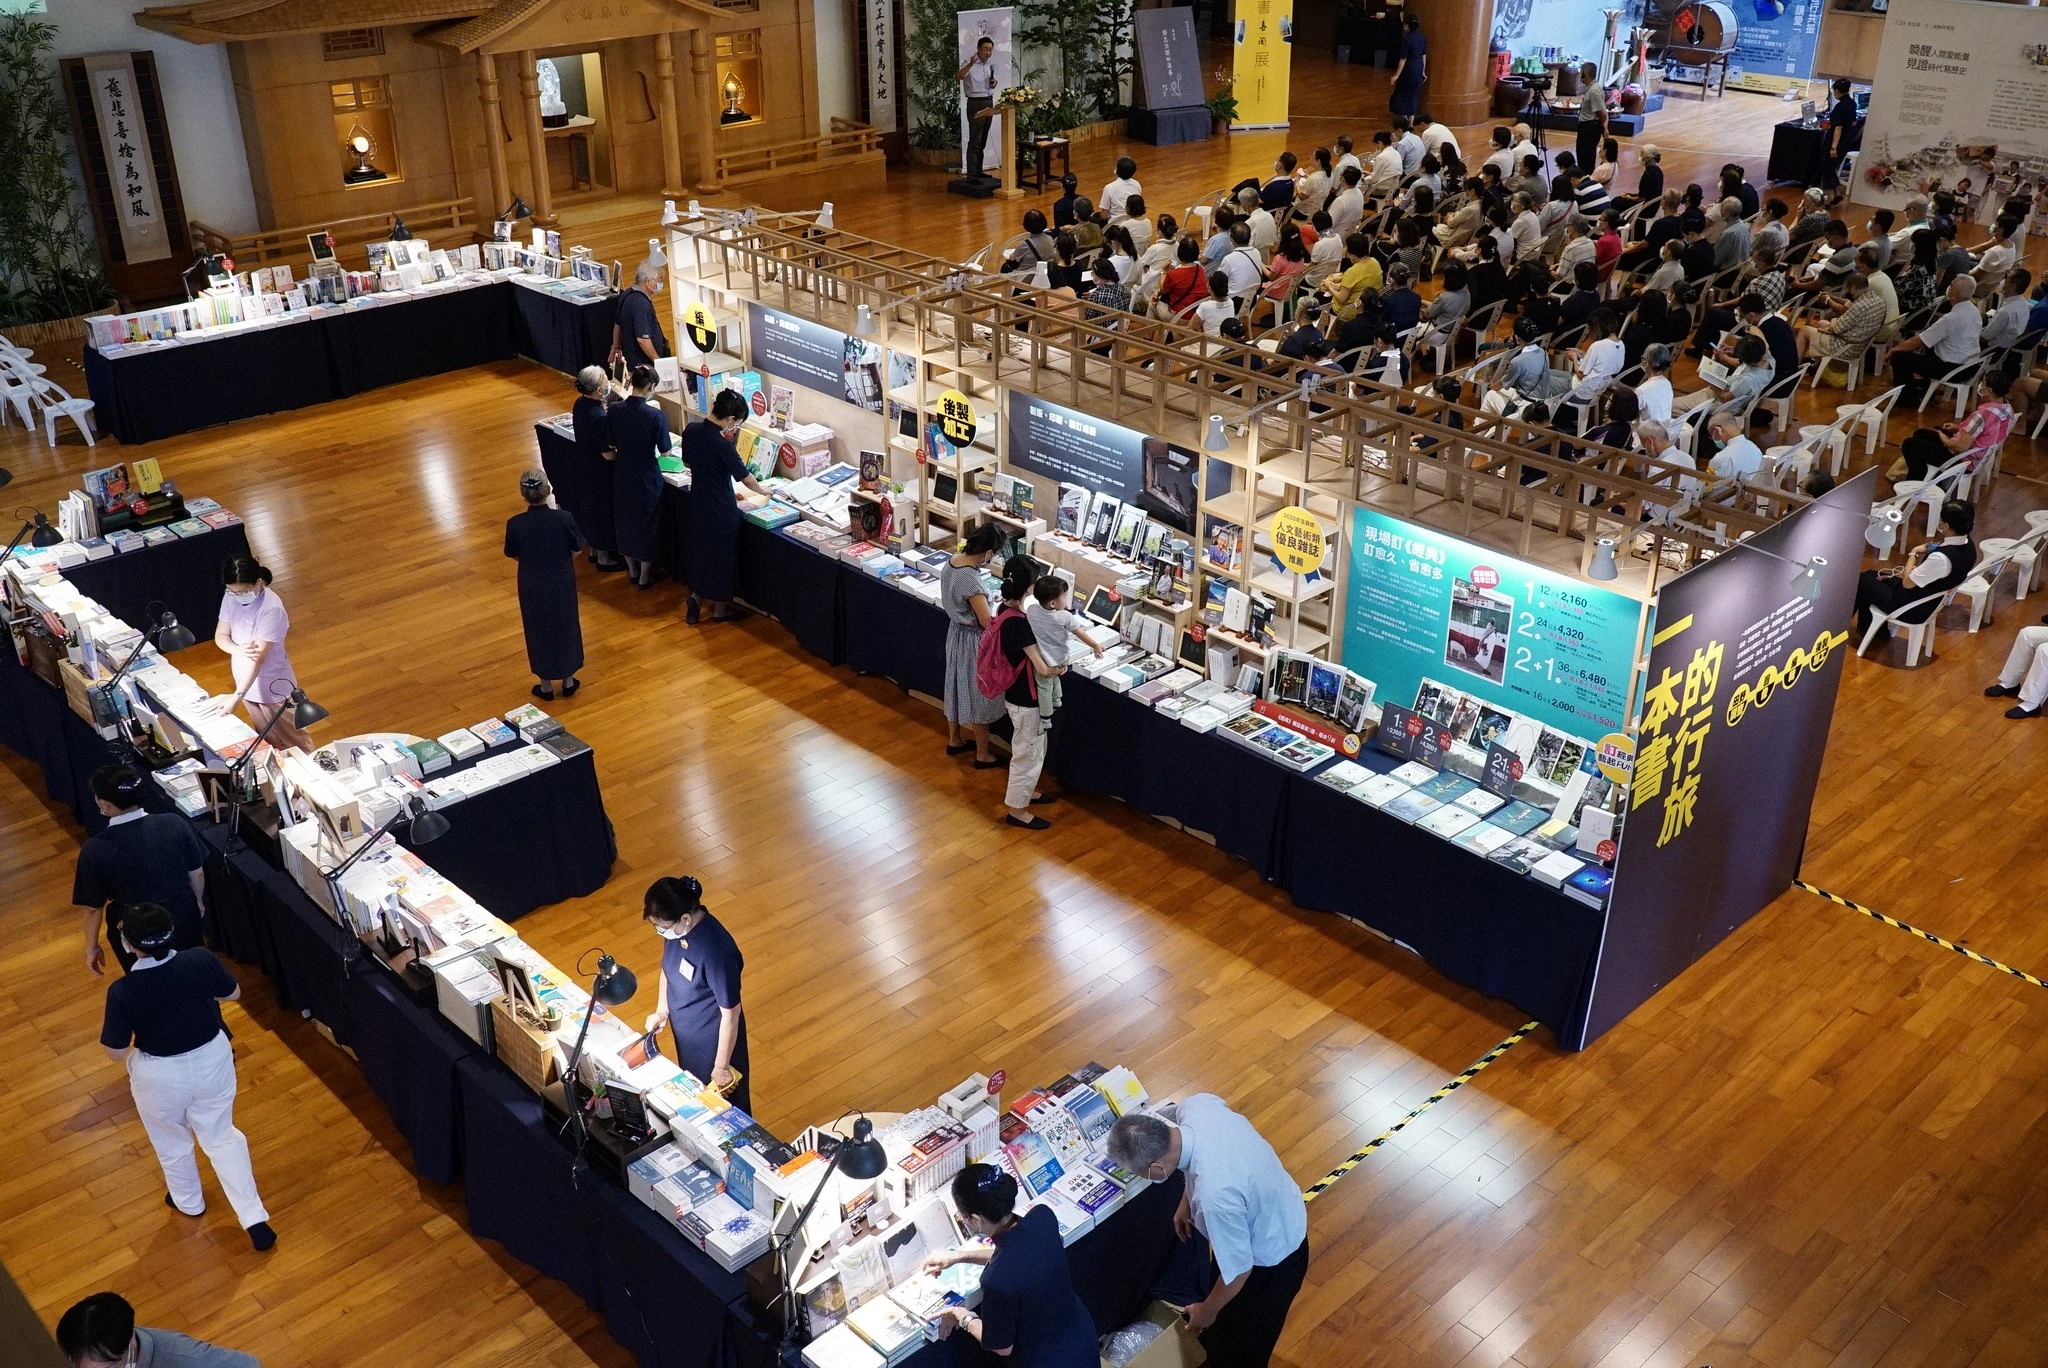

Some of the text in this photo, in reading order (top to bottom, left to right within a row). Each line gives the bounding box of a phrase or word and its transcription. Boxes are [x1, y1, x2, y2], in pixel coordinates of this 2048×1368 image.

[104, 77, 150, 217] 慈悲喜捨為和風
[943, 397, 969, 422] 後製
[943, 417, 970, 441] 加工
[1276, 531, 1319, 558] 優良雜誌
[1277, 521, 1320, 545] 人文藝術類
[1288, 554, 1304, 567] 推薦
[1363, 542, 1444, 580] 訂愈久、省愈多
[730, 1165, 753, 1191] PEAK
[1068, 1174, 1083, 1185] OKR
